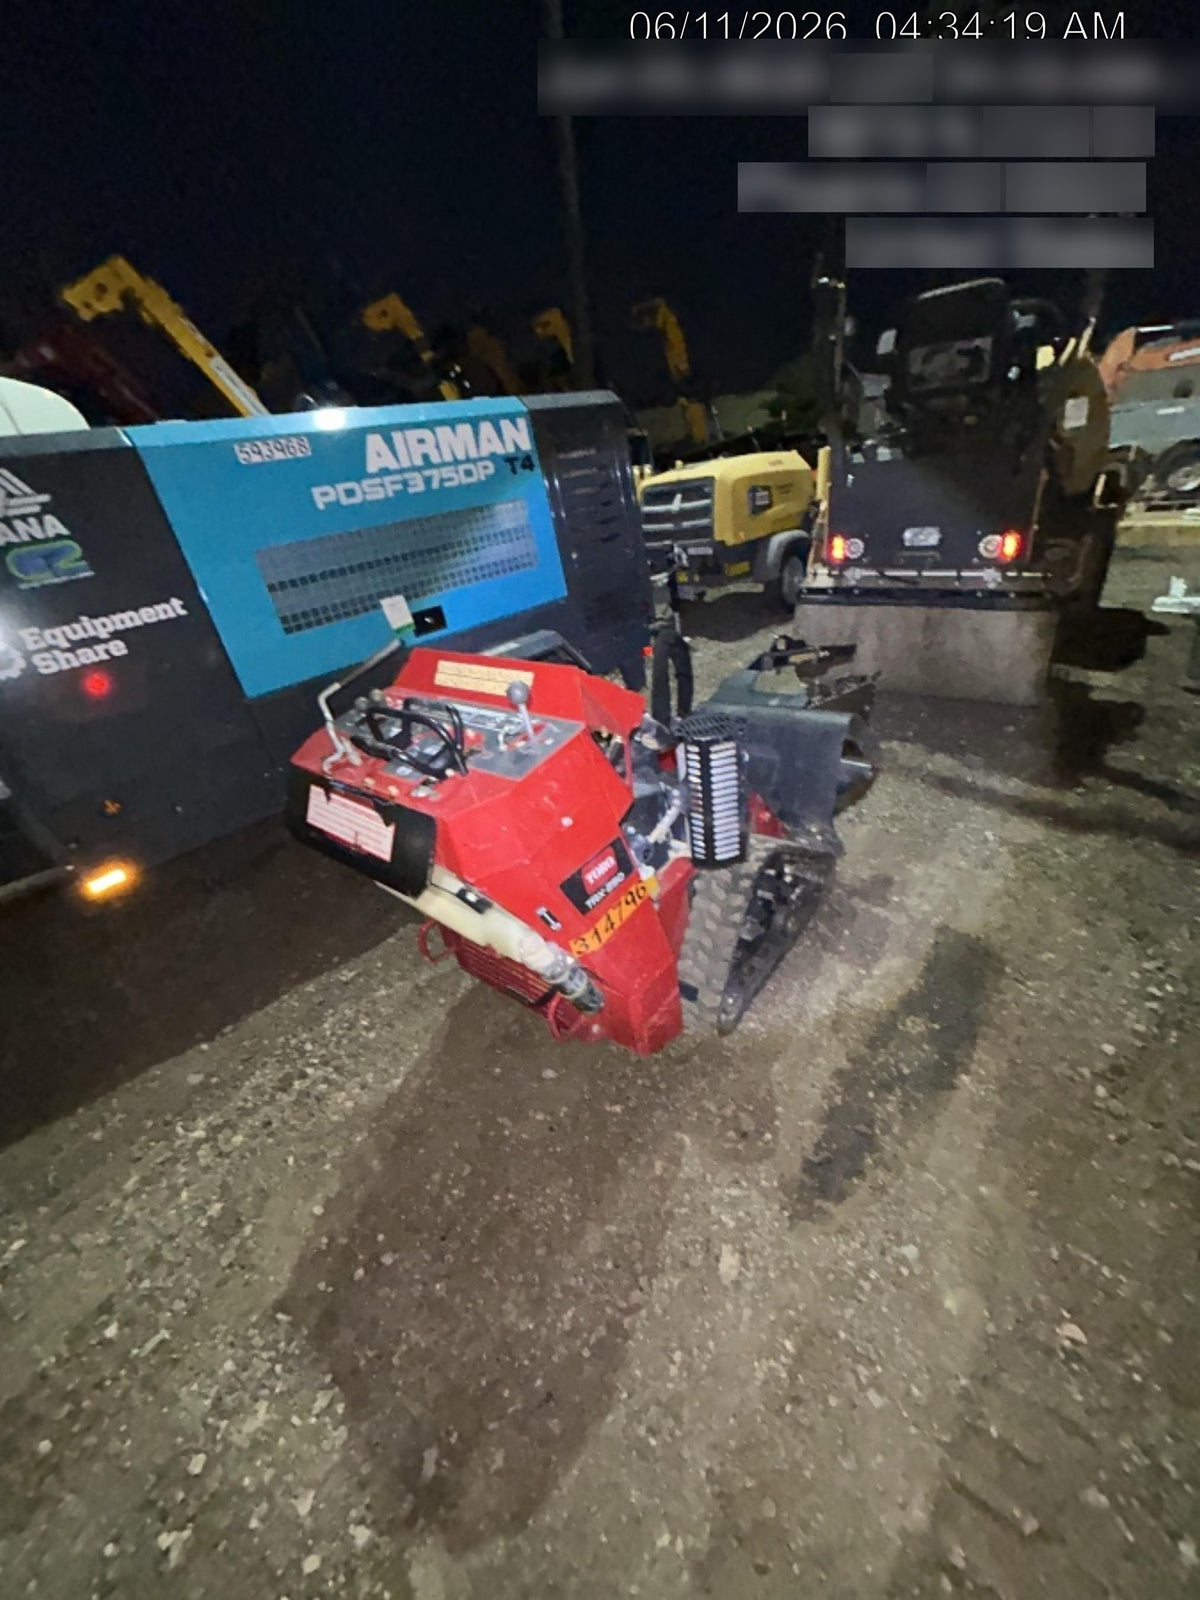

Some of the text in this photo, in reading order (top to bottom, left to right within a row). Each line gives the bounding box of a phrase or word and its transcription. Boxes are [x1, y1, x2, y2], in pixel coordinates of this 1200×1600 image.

[236, 436, 309, 463] 593968
[365, 417, 532, 474] AIRMAN
[311, 454, 535, 511] PDSF375DP T4
[19, 597, 188, 651] Equipment
[31, 639, 128, 675] Share
[573, 880, 647, 955] 314796
